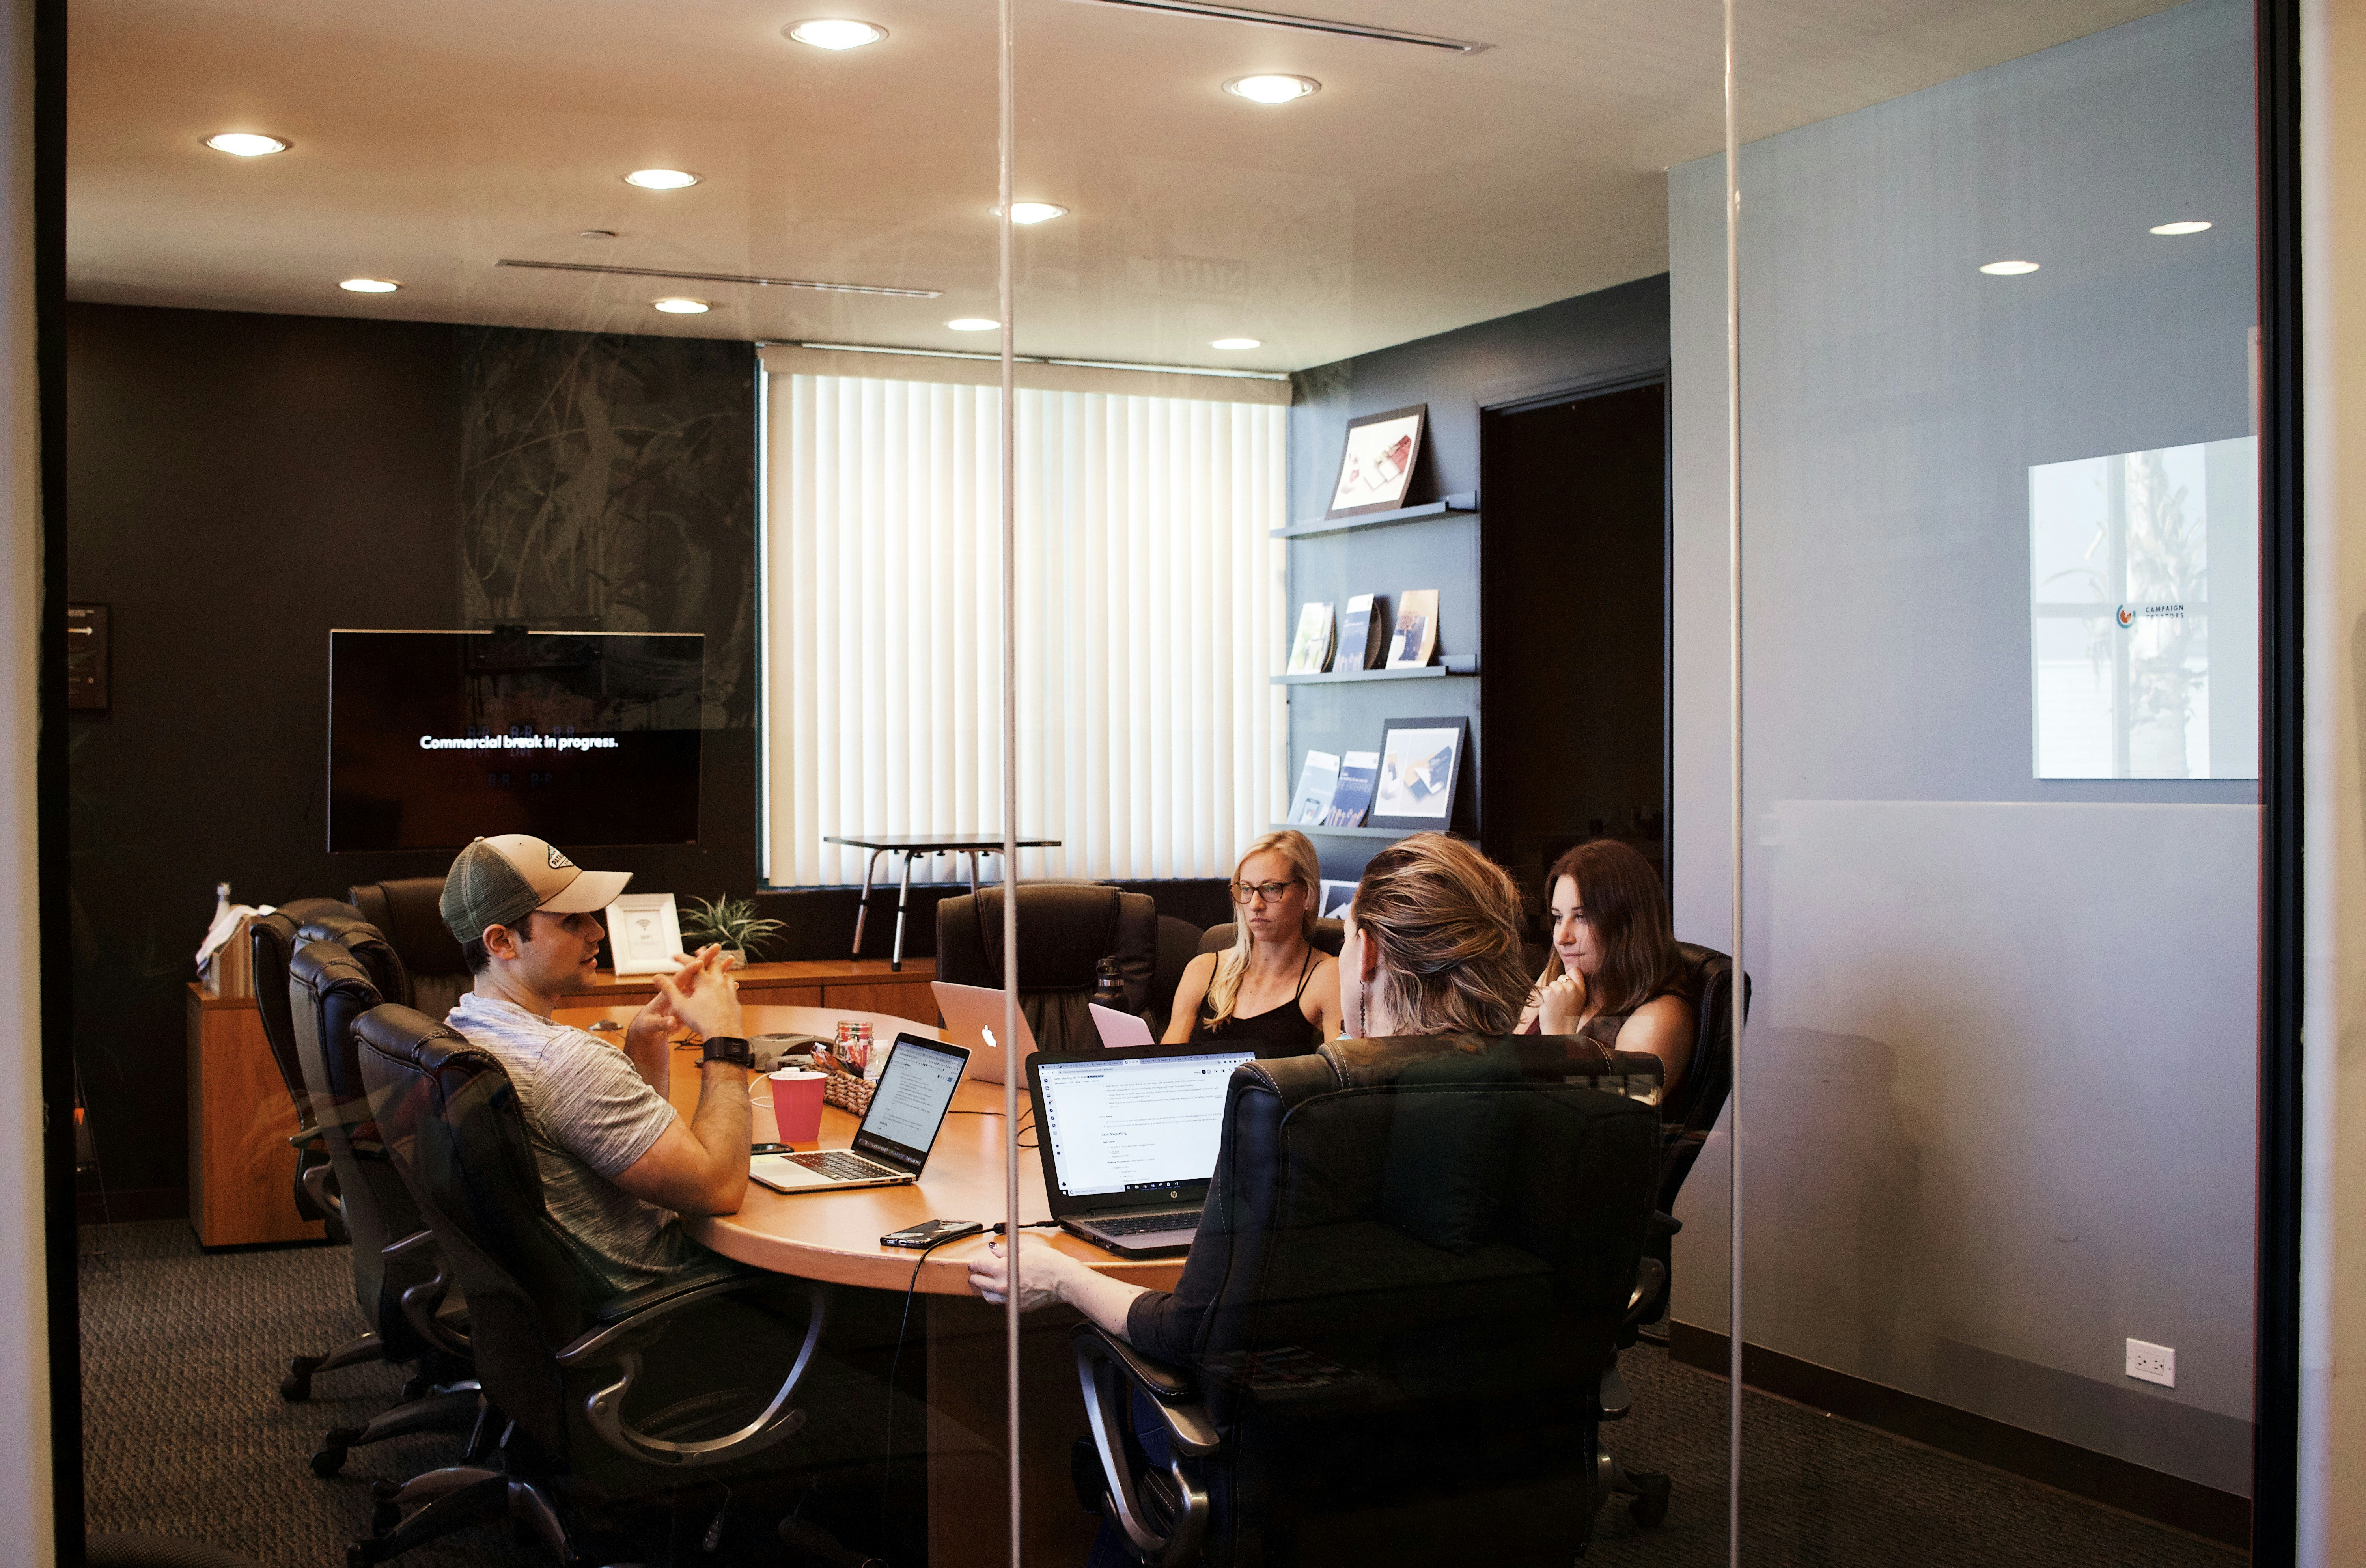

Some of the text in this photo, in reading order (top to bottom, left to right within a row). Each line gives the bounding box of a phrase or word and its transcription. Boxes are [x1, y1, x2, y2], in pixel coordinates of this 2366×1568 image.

[420, 735, 619, 751] Commercial break in progress.
